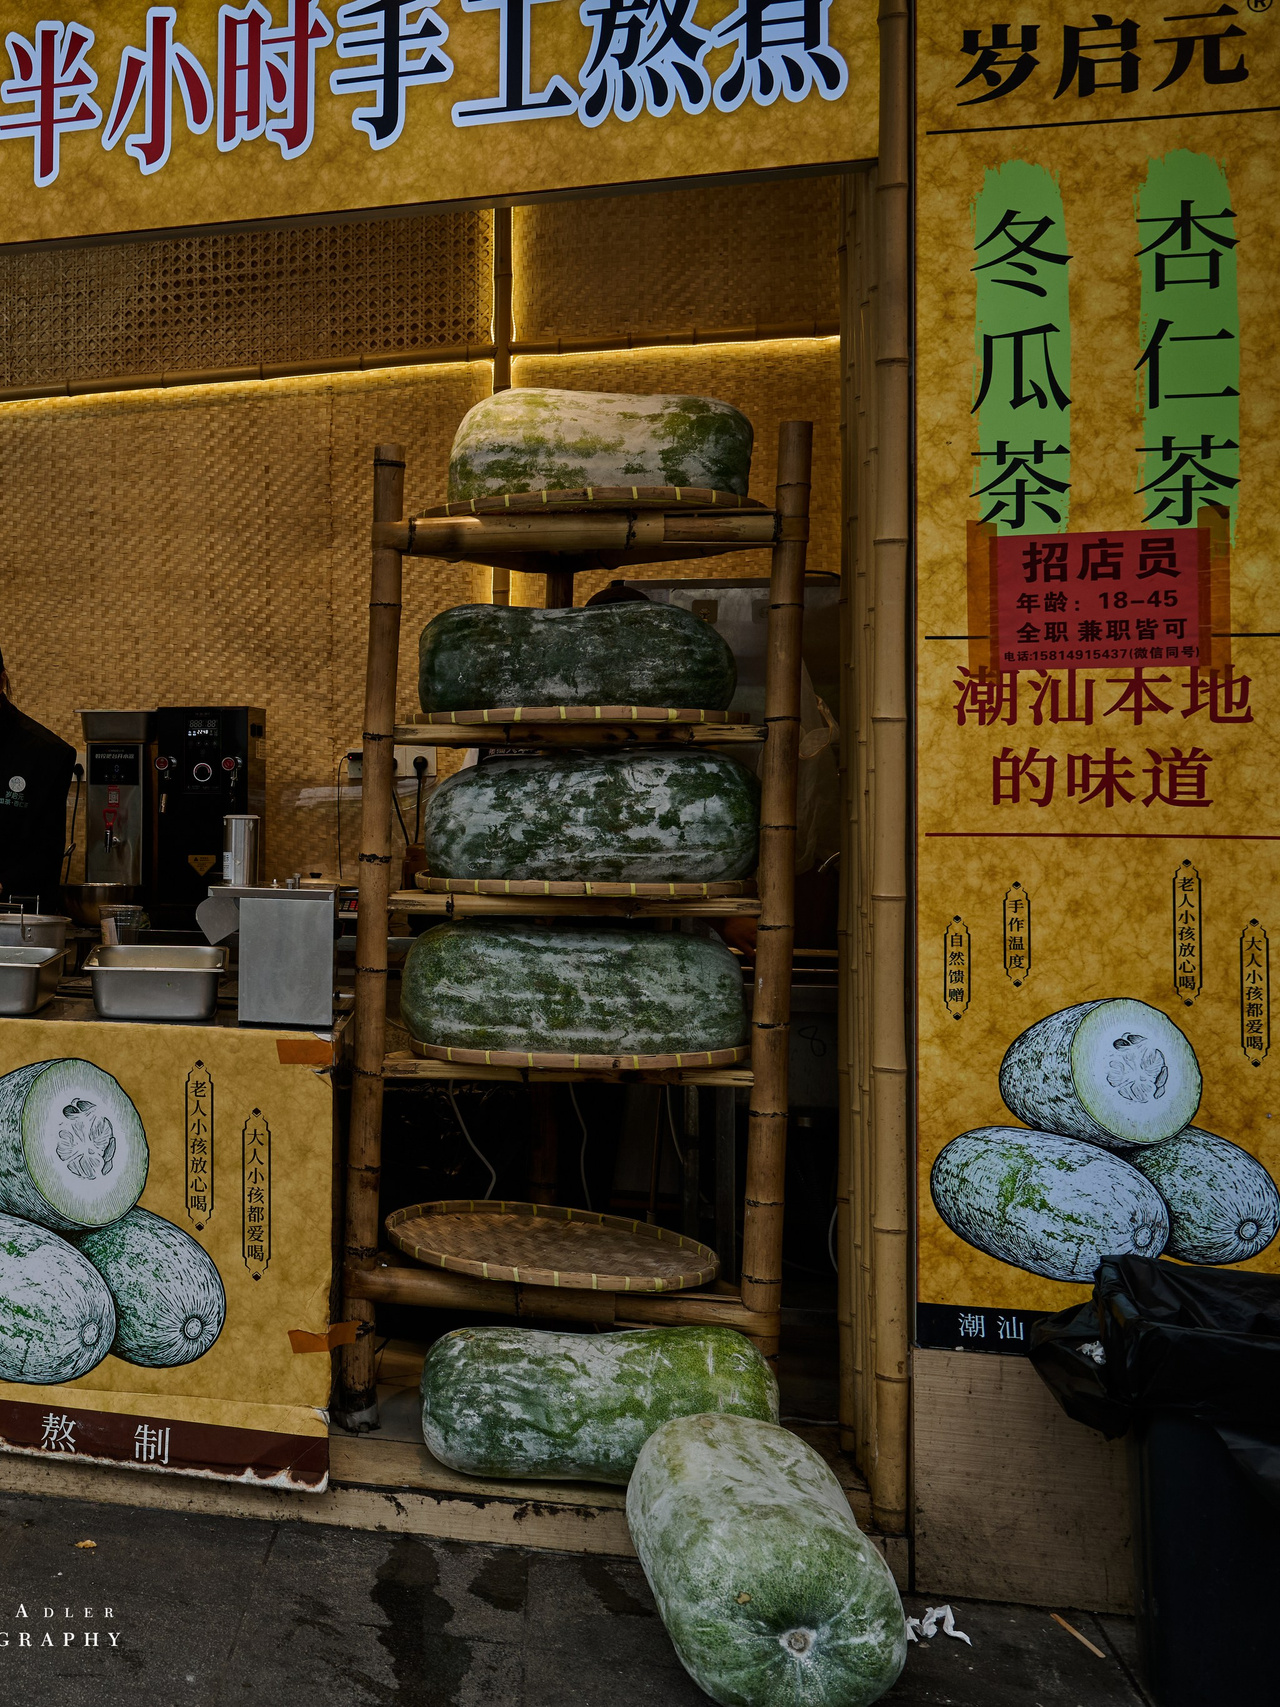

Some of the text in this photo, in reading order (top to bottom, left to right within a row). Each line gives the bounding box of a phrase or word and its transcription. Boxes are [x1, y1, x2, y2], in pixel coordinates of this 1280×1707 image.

[956, 4, 1249, 107] 岁启元
[969, 209, 1073, 529] 冬瓜茶
[1134, 200, 1241, 526] 杏仁茶
[1022, 538, 1182, 584] 招店员
[953, 664, 1254, 726] 潮汕本地
[992, 747, 1214, 808] 的味道
[948, 932, 965, 1003] 自然馈赠
[1008, 899, 1025, 969] 手作温度
[1177, 877, 1196, 991] 老人小孩放心喝
[1245, 936, 1264, 1051] 大人小孩都爱喝
[190, 1080, 207, 1213] 老人小孩放心喝
[247, 1129, 265, 1262] 大人小孩都爱喝
